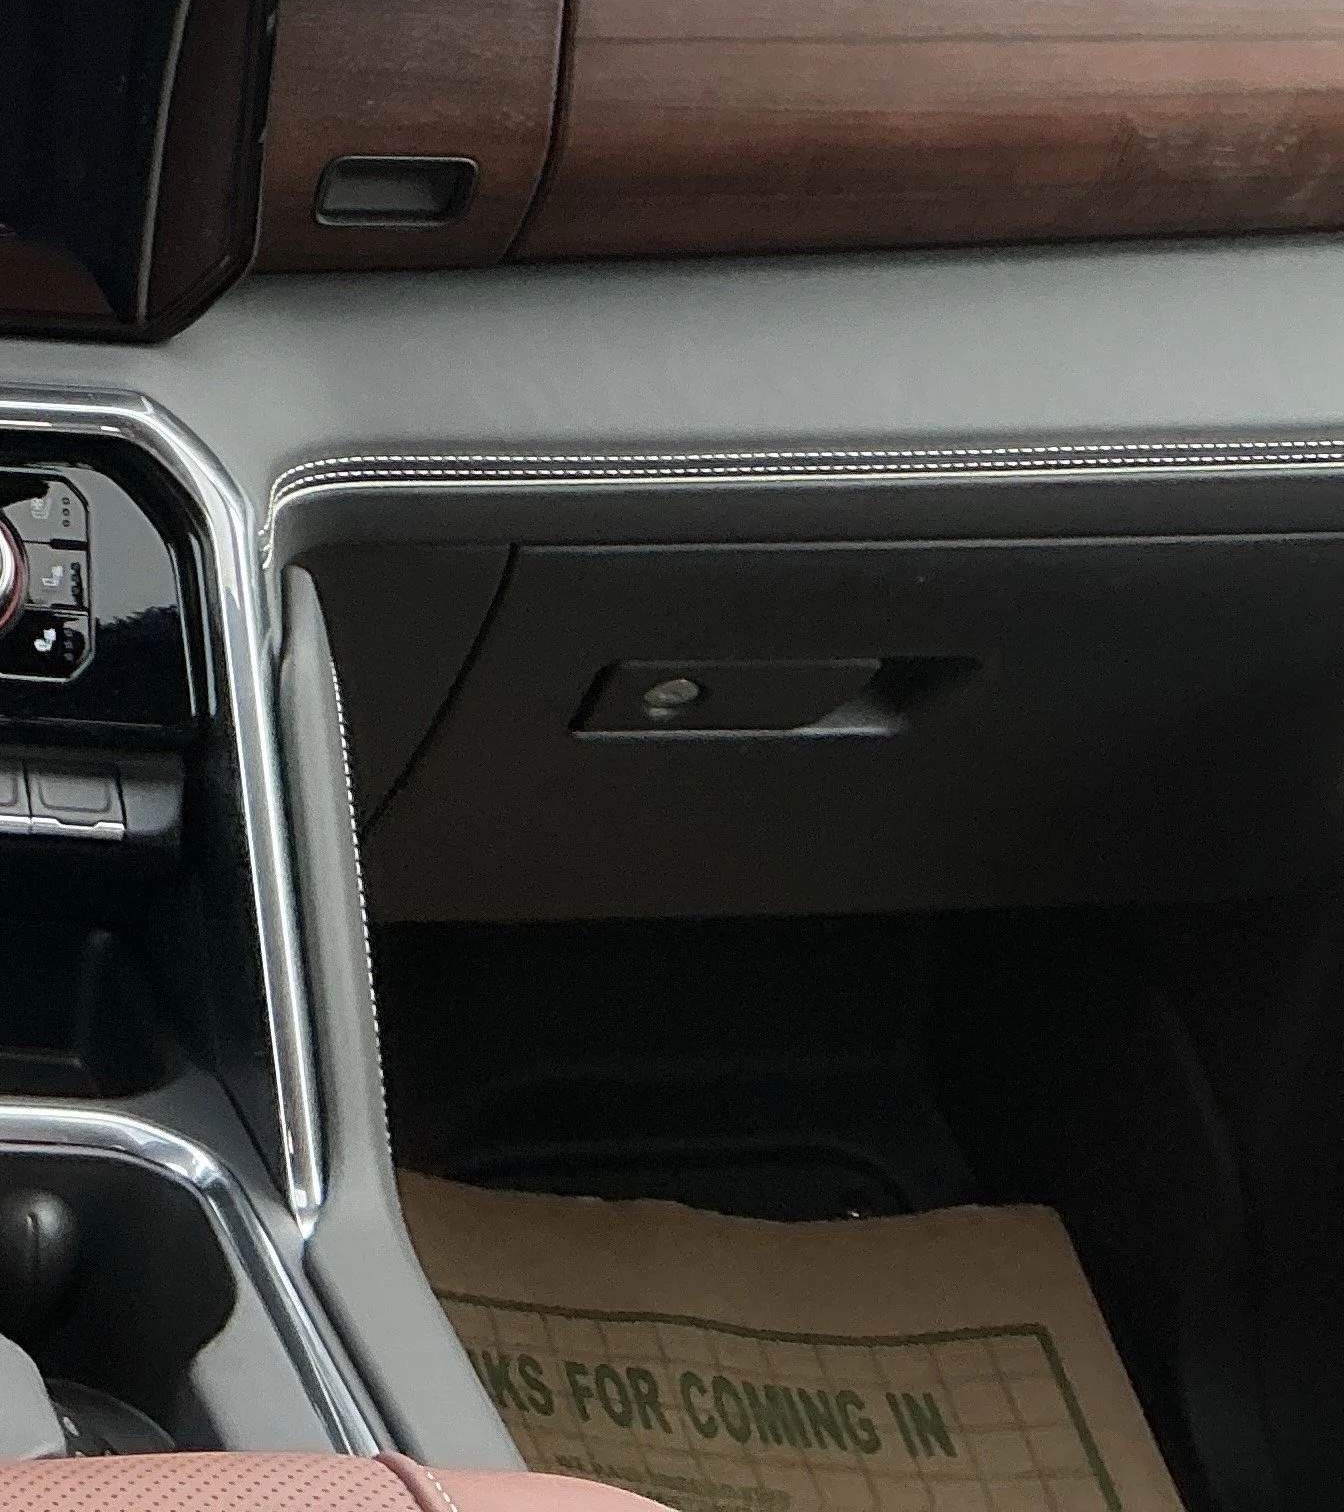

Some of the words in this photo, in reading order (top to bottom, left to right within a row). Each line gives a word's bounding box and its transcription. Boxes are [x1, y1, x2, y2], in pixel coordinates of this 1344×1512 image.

[467, 1348, 554, 1417] KS
[564, 1360, 673, 1435] FOR
[679, 1370, 883, 1455] COMING
[886, 1391, 958, 1459] IN
